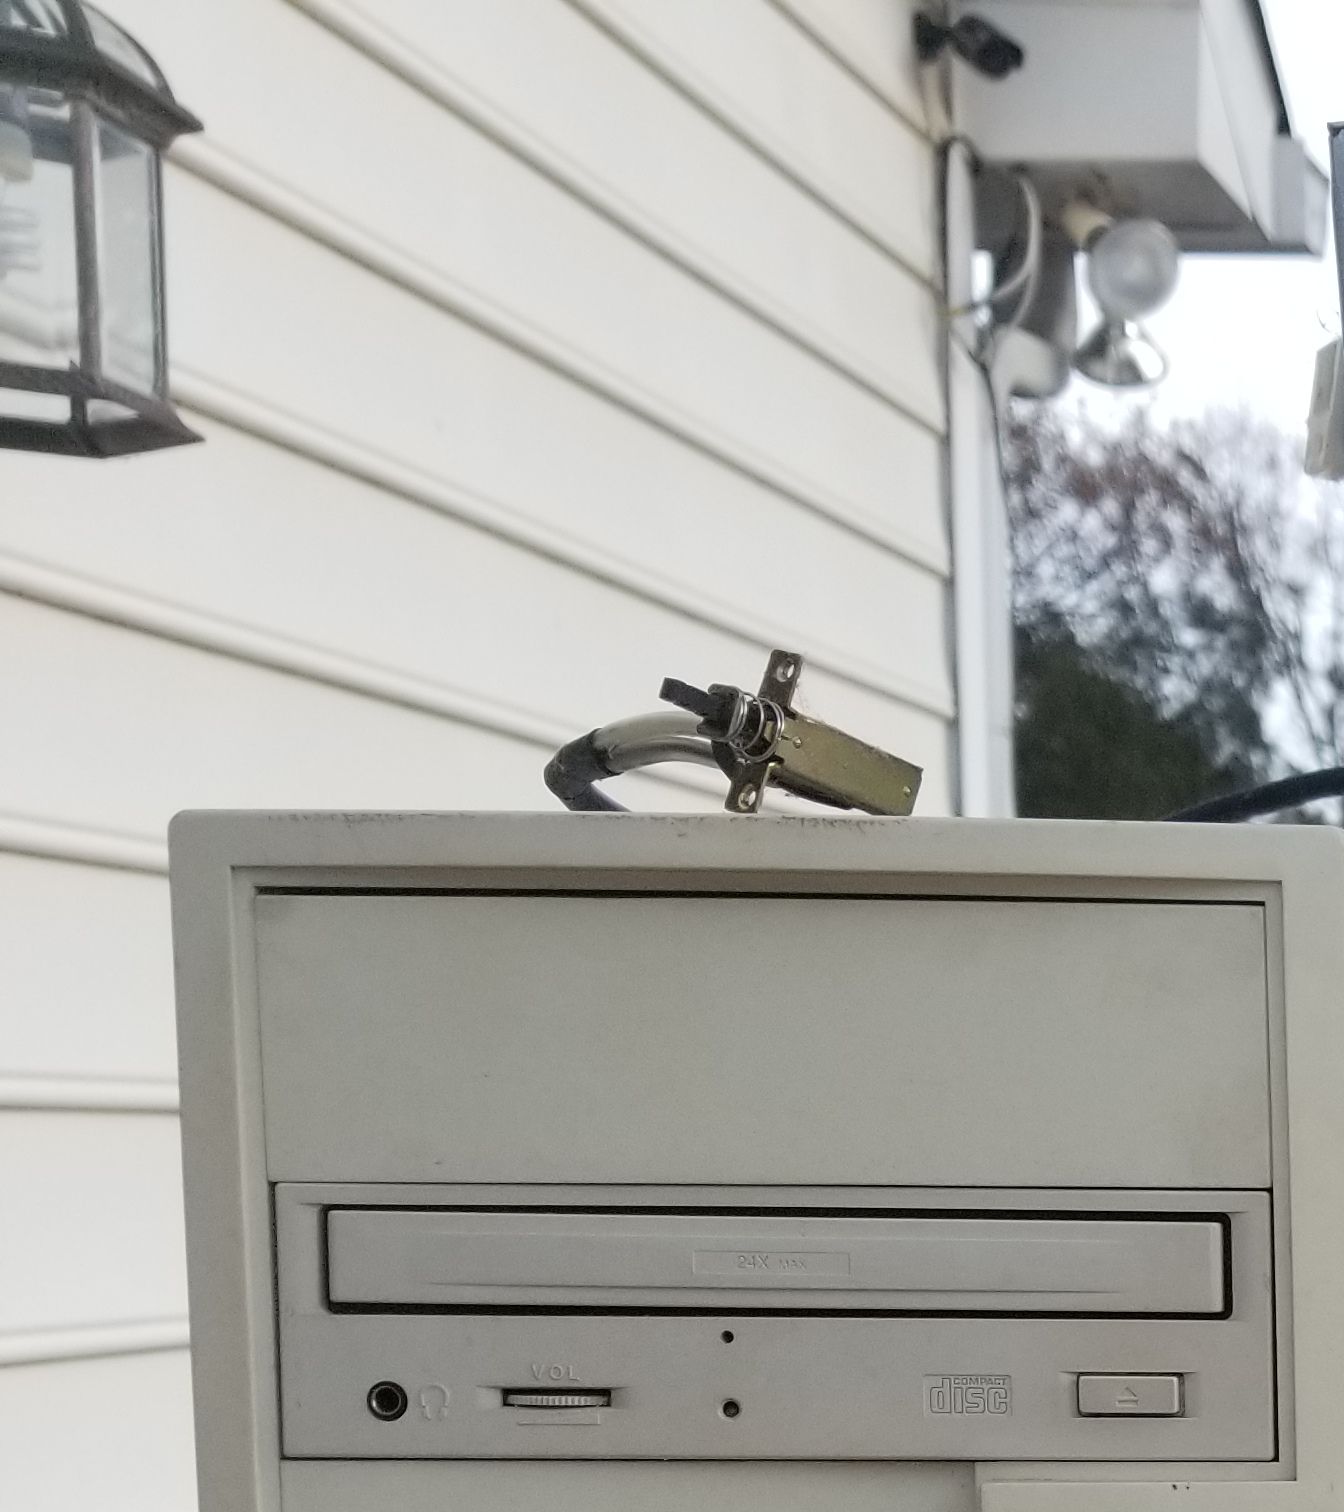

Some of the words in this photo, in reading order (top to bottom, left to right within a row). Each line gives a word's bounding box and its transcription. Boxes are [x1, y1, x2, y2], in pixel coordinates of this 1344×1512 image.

[737, 1254, 769, 1269] 24X
[953, 1377, 1007, 1386] COMPACT
[929, 1377, 1008, 1414] disc
